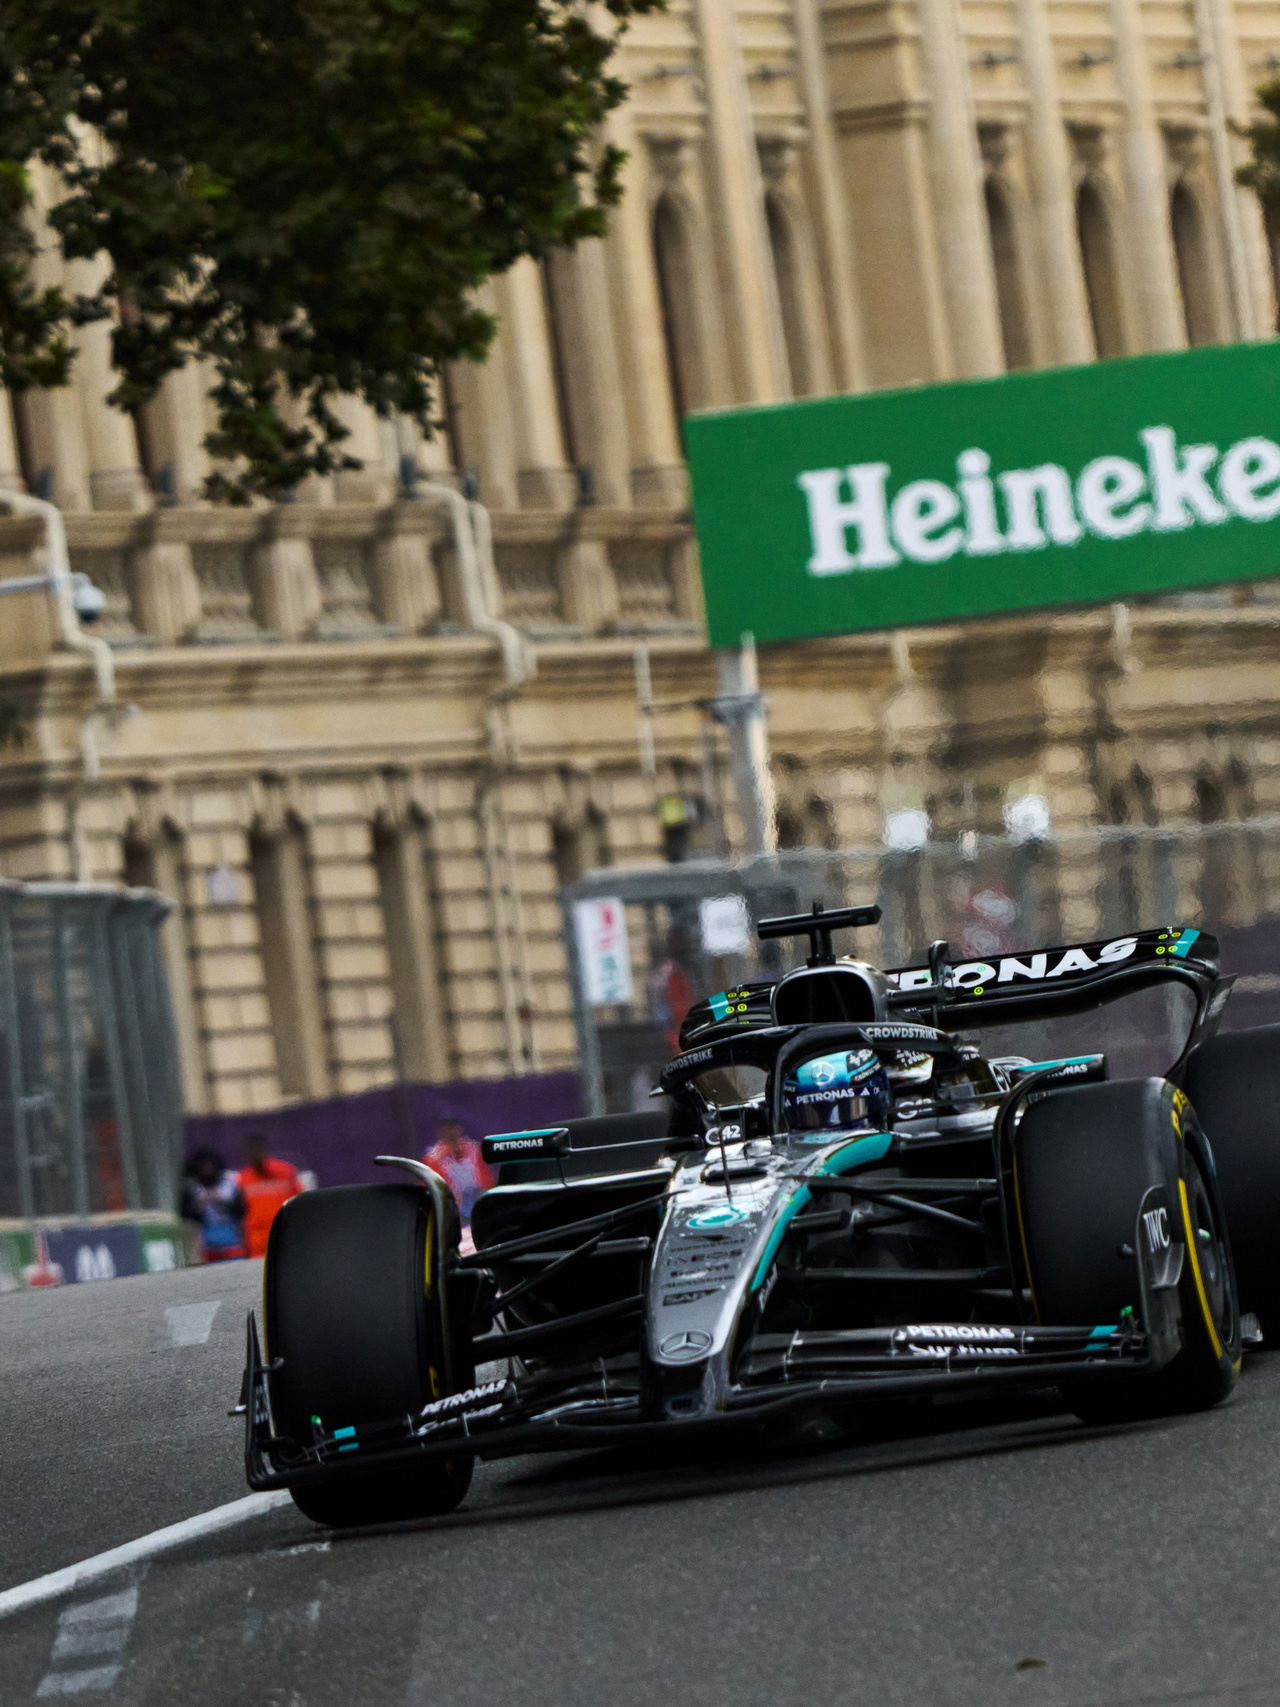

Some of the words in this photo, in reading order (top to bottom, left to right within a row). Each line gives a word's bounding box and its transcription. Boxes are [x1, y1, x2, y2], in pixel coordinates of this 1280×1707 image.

[864, 1026, 938, 1041] CROWDSTRIKE
[795, 1087, 855, 1105] PETRONAS
[493, 1138, 544, 1151] PETRONAS
[1143, 1207, 1170, 1253] IWC
[906, 1325, 1016, 1339] PETRONAS
[420, 1379, 507, 1417] PETRONAS
